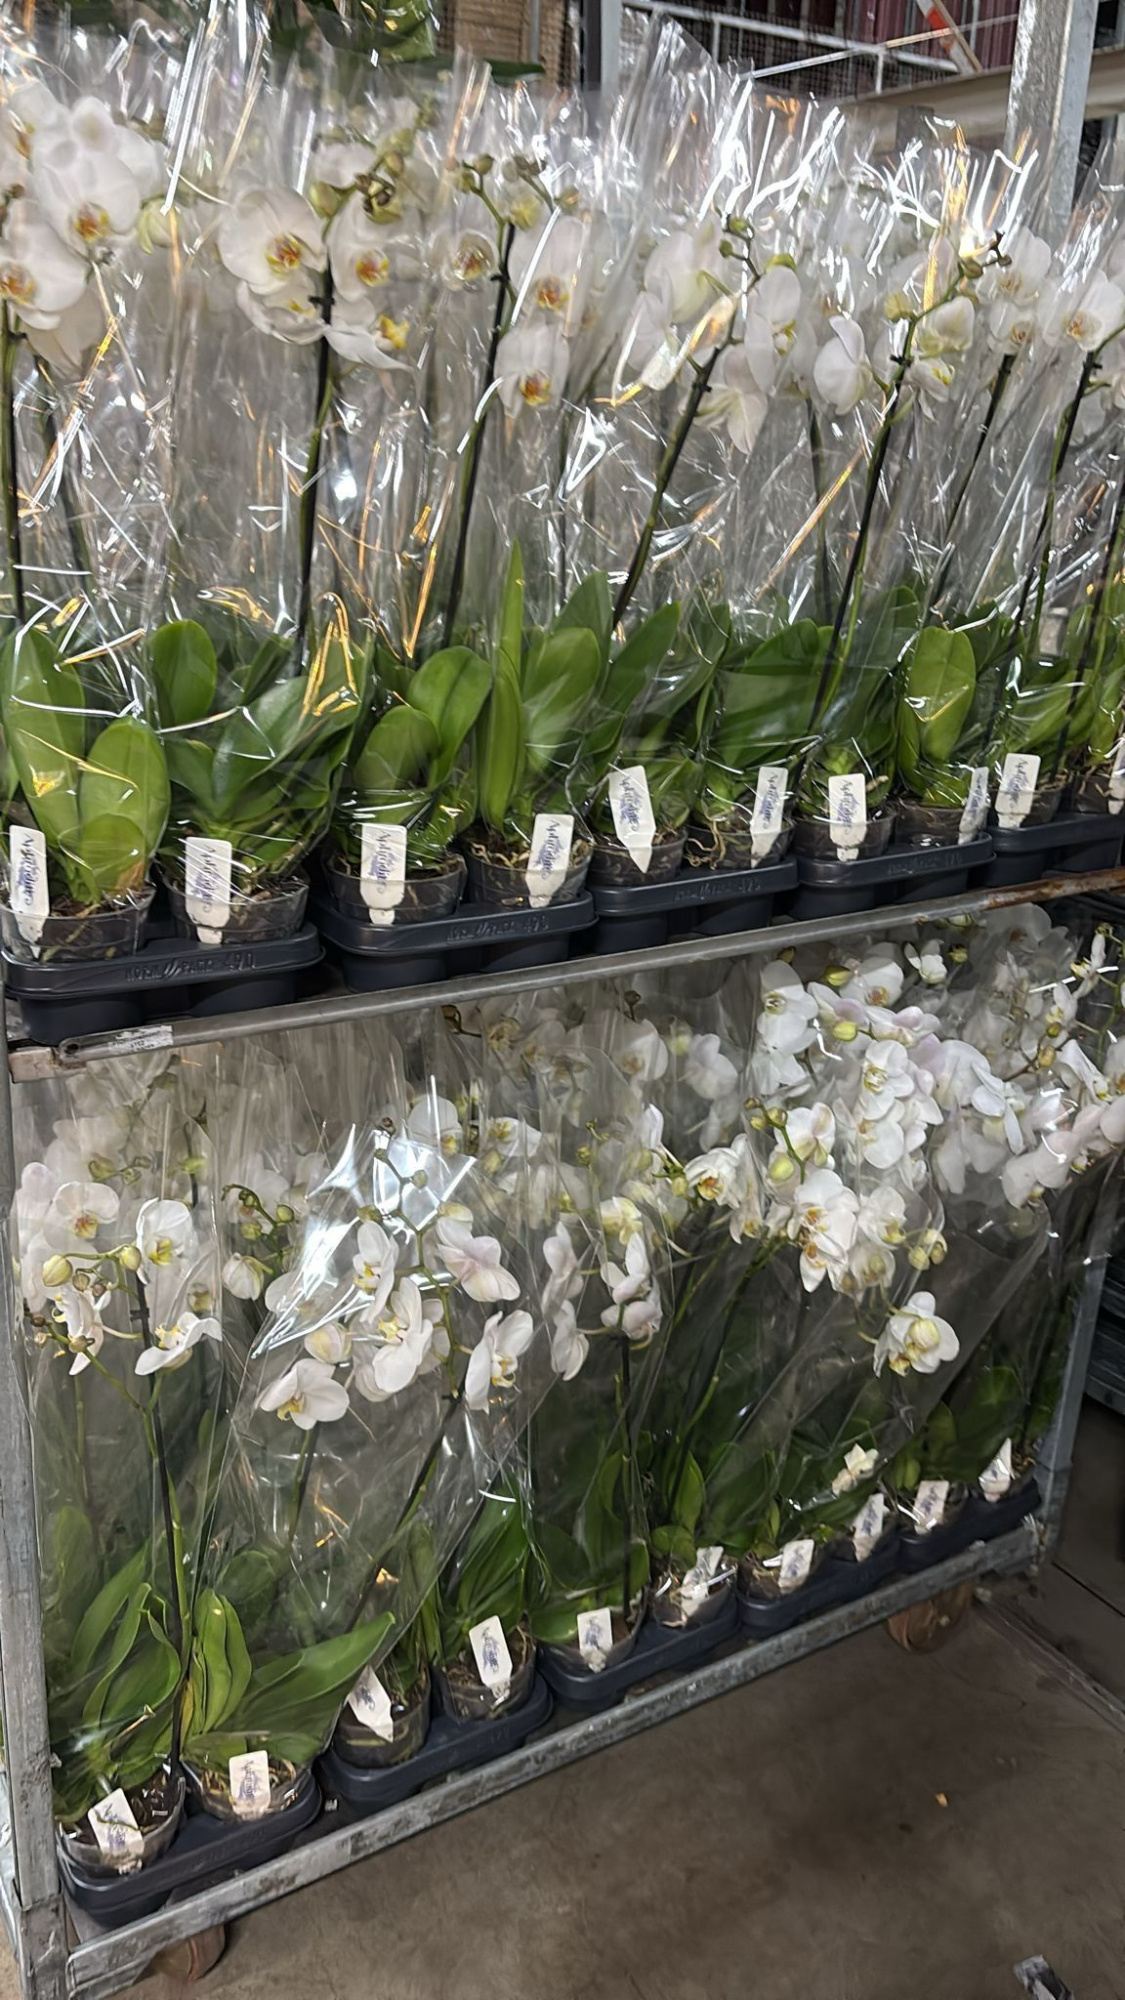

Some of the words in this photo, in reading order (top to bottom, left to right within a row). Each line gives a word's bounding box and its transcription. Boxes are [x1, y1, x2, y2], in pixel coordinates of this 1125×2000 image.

[616, 773, 642, 833] Aphrodite
[761, 772, 781, 830] Aphrodite
[839, 779, 854, 836] Aphrodite
[21, 833, 39, 907] Aphrodite
[202, 846, 221, 914] Aphrodite
[373, 830, 391, 895] Aphrodite
[541, 820, 560, 880] Aphrodite
